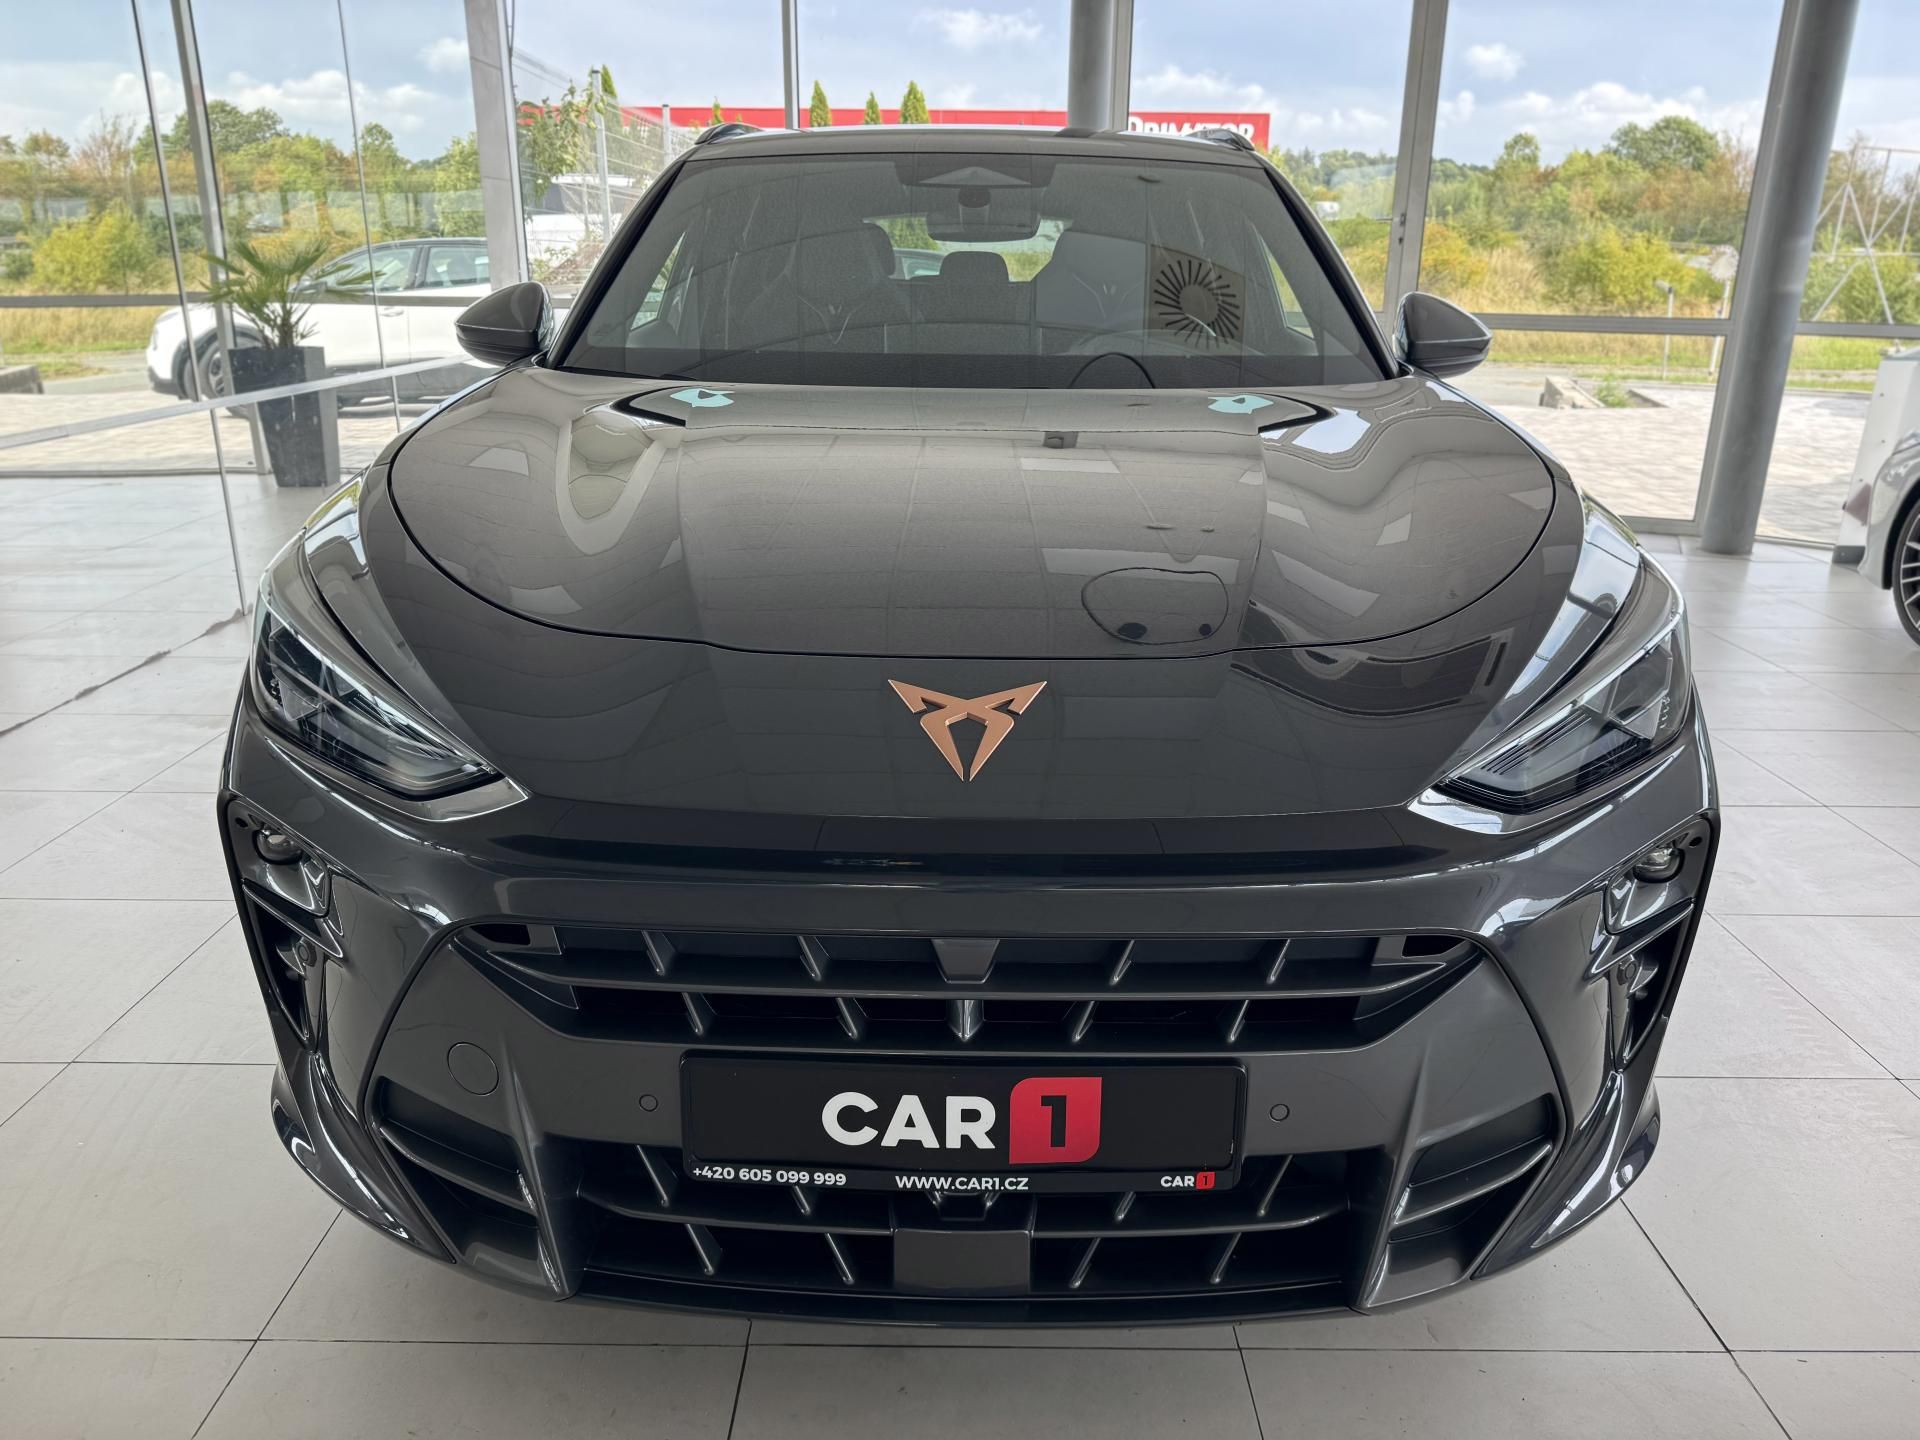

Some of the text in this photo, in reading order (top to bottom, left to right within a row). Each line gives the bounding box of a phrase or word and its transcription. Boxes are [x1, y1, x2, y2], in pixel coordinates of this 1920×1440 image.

[692, 1166, 847, 1186] +420 605 099 999
[894, 1175, 1029, 1190] WWW.CAR1.CZ
